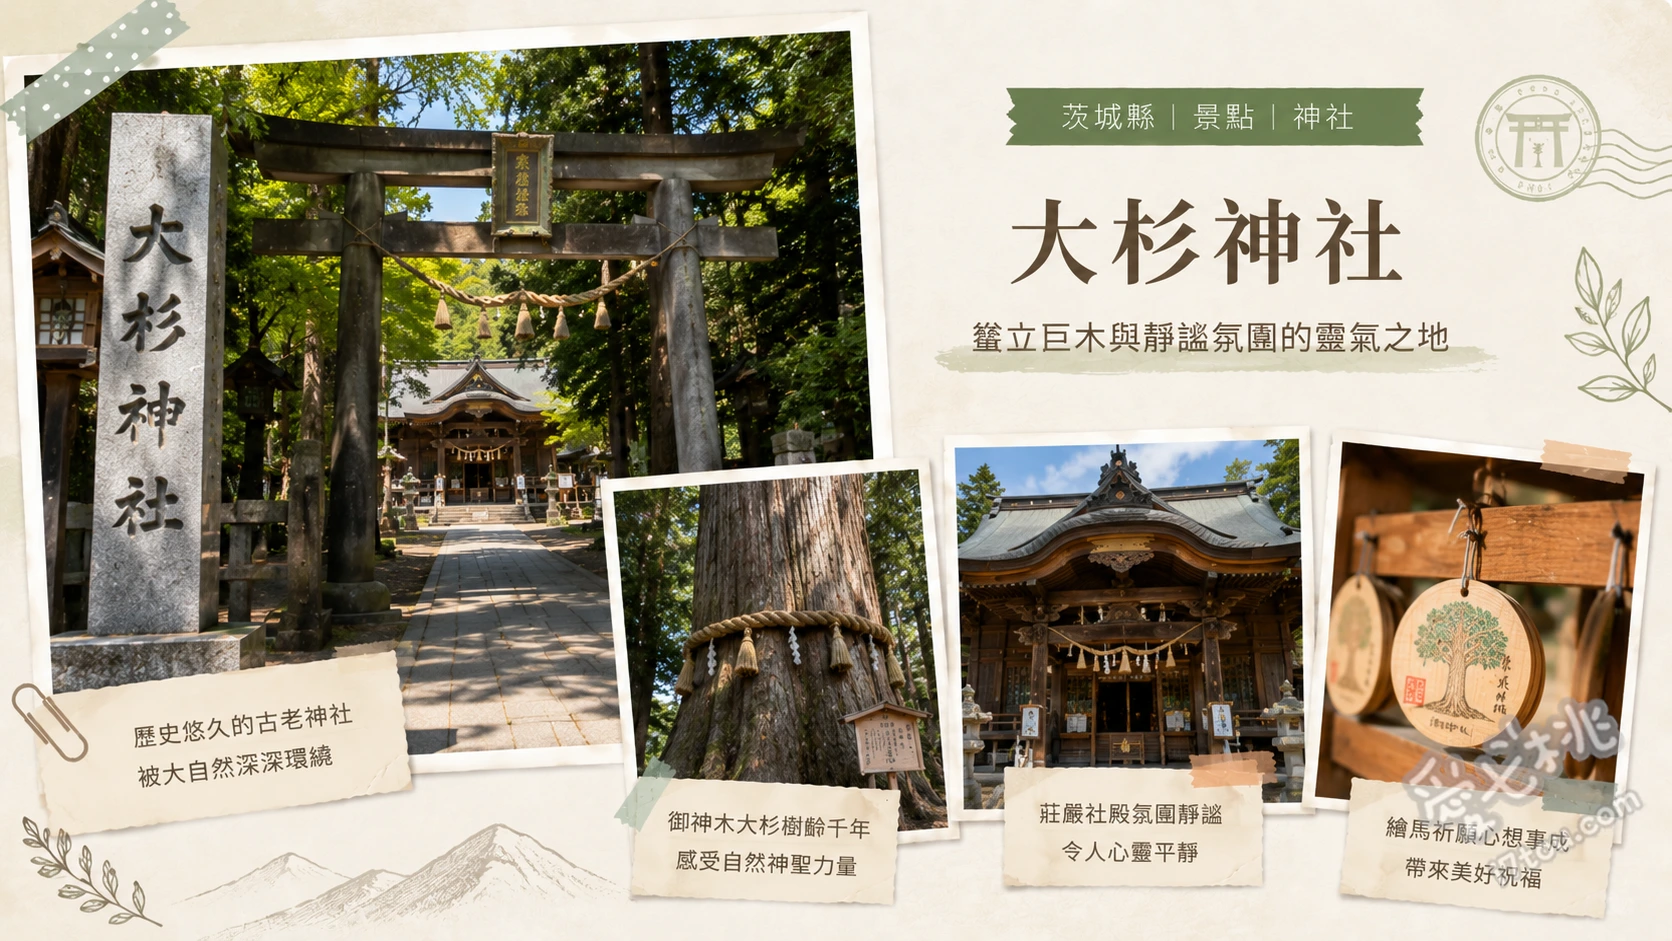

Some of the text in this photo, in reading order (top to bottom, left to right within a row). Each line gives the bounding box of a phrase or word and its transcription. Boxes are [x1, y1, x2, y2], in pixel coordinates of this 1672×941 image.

[1062, 102, 1354, 131] 茨城縣 景點 神社
[1010, 198, 1403, 285] 大杉神社
[111, 203, 193, 538] 大杉神社
[134, 702, 353, 748] 歷史悠久的古老神社
[137, 744, 333, 788] 被大自然深深環繞
[667, 810, 871, 839] 御神木大杉樹齡千年
[1039, 802, 1223, 825] 莊嚴社殿氛圍靜謐
[1385, 816, 1570, 853] 繪馬祈願心想事成
[675, 849, 857, 876] 感受自然神聖力量
[1061, 840, 1199, 863] 令人心靈平靜
[1405, 856, 1543, 889] 帶來美好祝福
